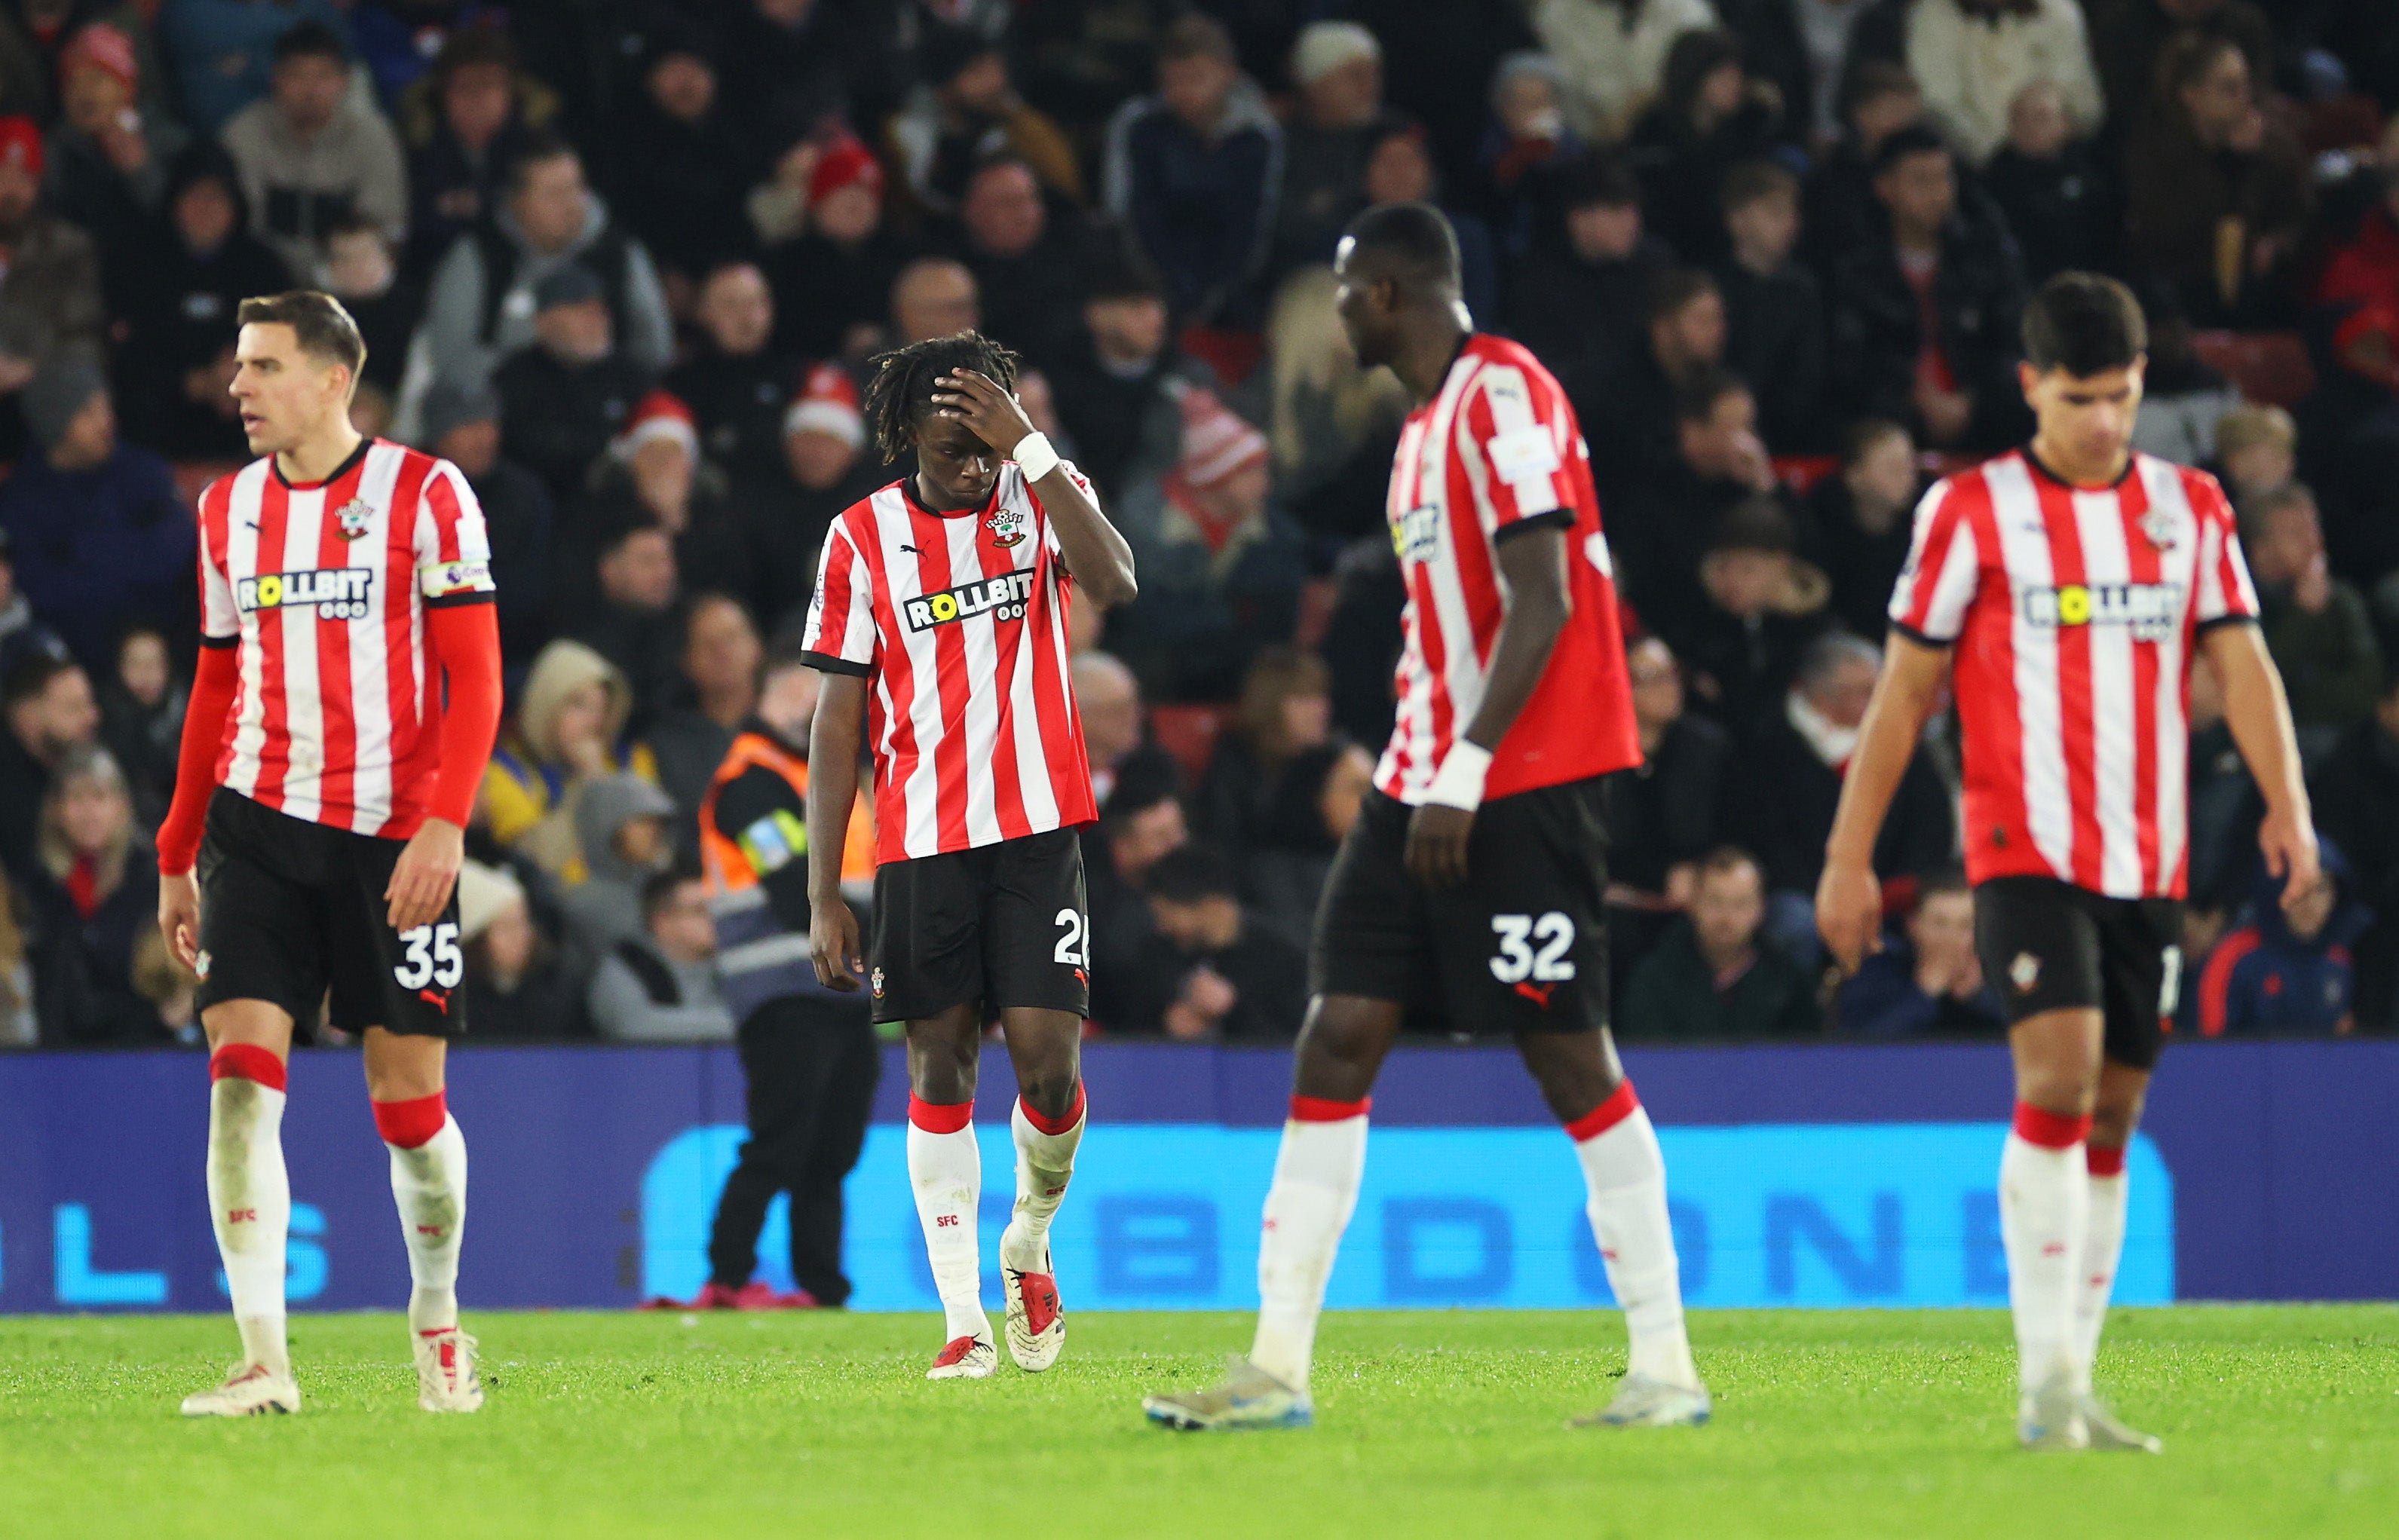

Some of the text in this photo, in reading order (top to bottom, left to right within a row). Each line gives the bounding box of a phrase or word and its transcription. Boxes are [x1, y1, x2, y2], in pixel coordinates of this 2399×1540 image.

[239, 570, 370, 611] ROLLBIT
[907, 571, 1034, 629] ROLLBIT
[394, 922, 464, 990] 35
[1489, 911, 1576, 983] 32
[936, 1214, 959, 1227] SFC
